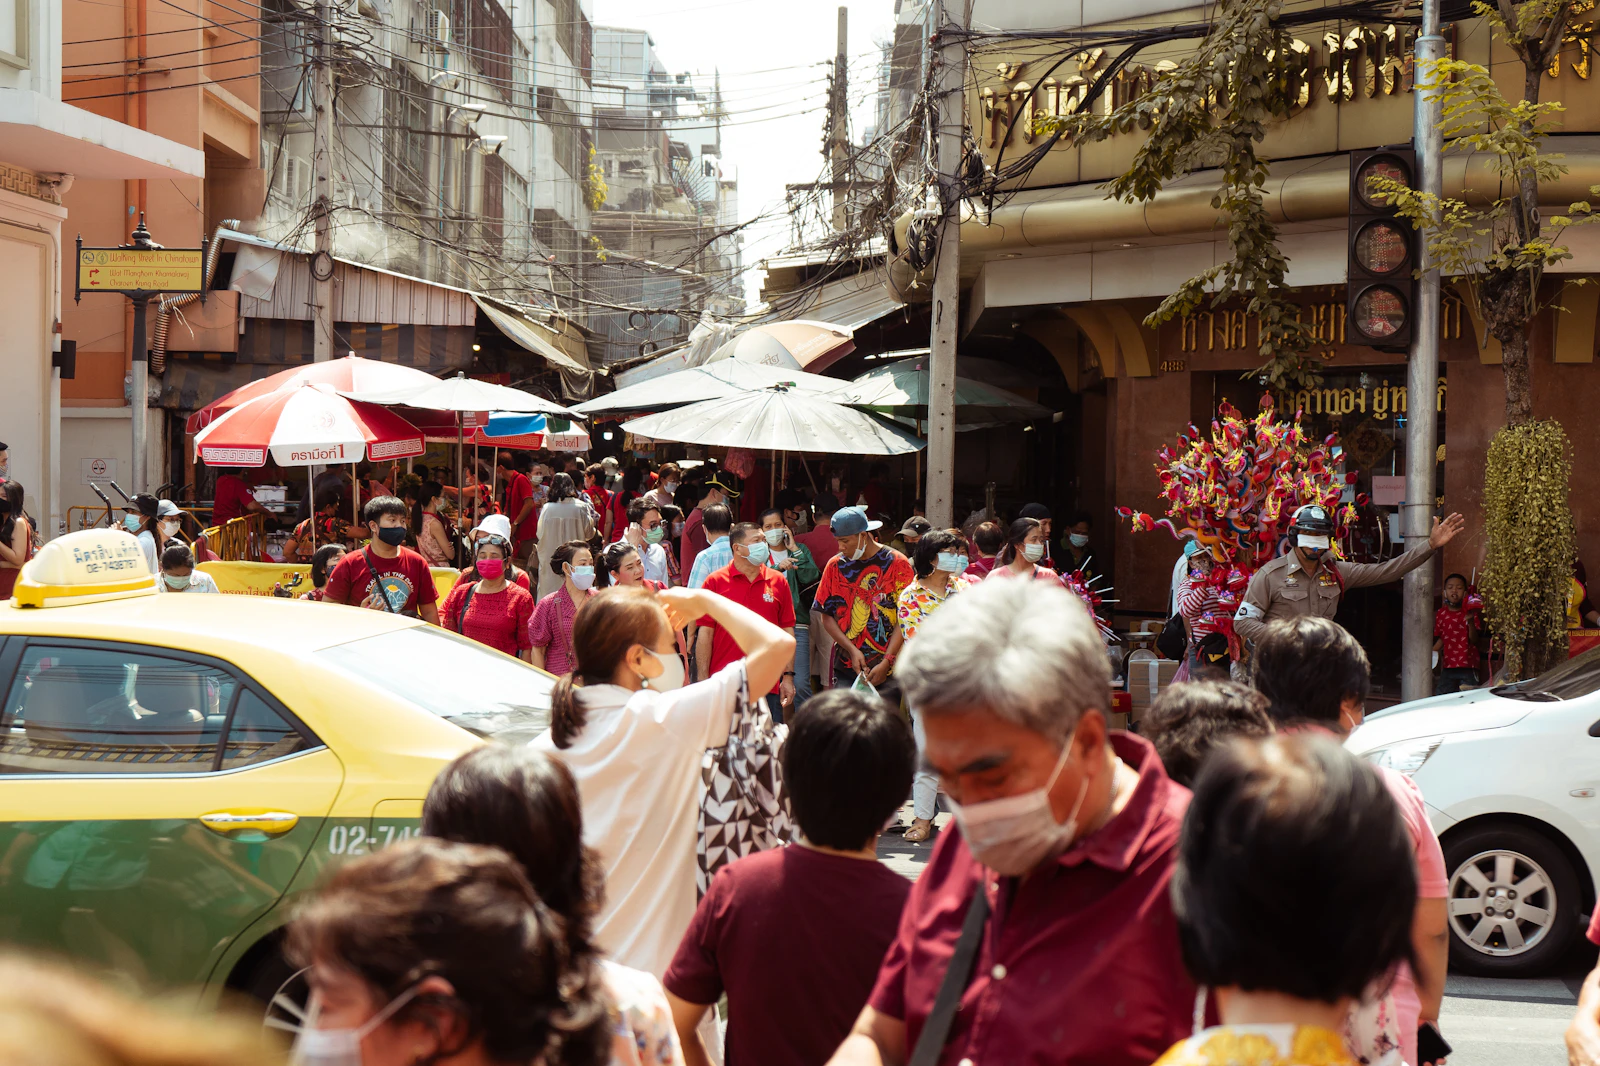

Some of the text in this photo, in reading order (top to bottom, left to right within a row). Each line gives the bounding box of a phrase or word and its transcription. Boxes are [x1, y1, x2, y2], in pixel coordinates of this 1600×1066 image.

[110, 252, 199, 265] Walking Street In Chinatown
[109, 269, 122, 277] Wat
[135, 279, 152, 289] Krung
[153, 279, 169, 288] Road
[1160, 360, 1185, 372] 488
[365, 574, 383, 593] TRAVL
[392, 572, 405, 580] THE
